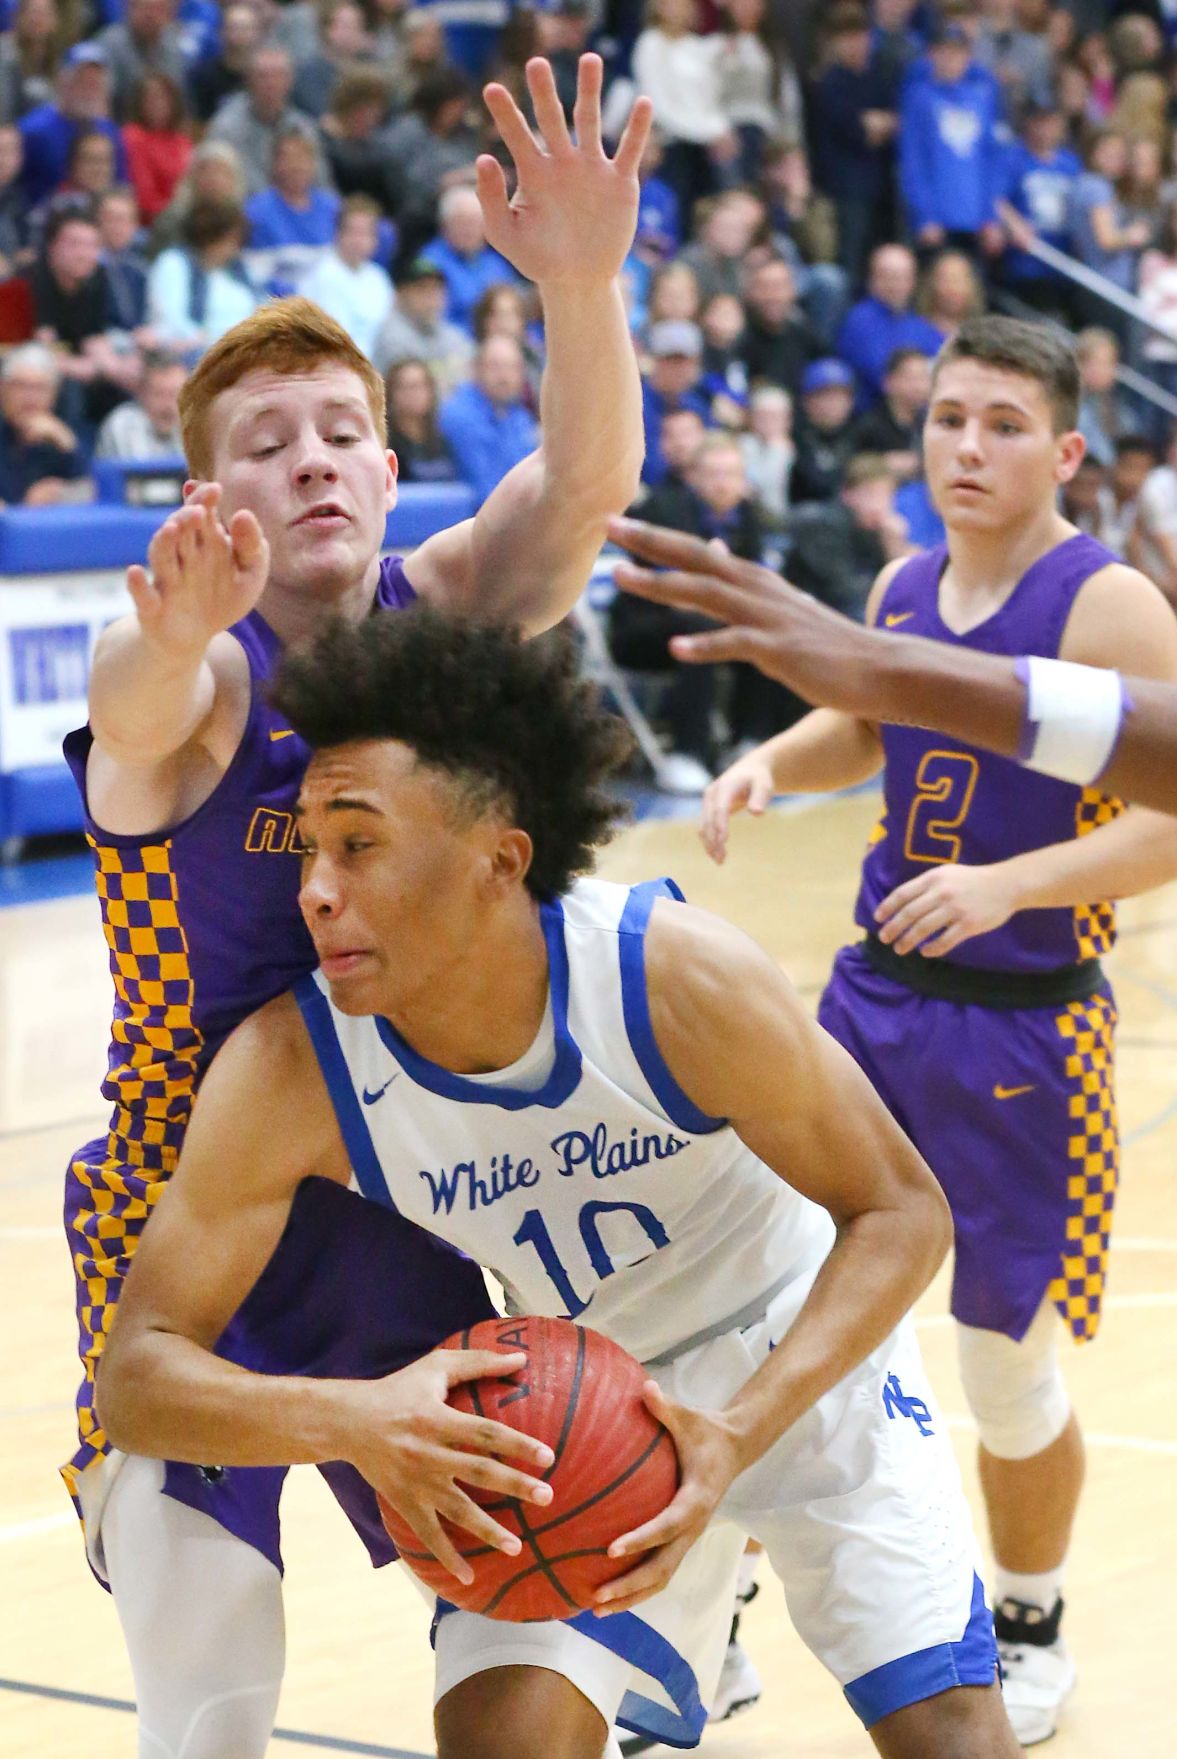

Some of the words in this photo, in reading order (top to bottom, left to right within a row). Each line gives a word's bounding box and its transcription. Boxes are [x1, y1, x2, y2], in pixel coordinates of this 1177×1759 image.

[904, 749, 980, 864] 2
[419, 1153, 541, 1216] White
[550, 1121, 691, 1179] Plains
[512, 1199, 672, 1321] 10
